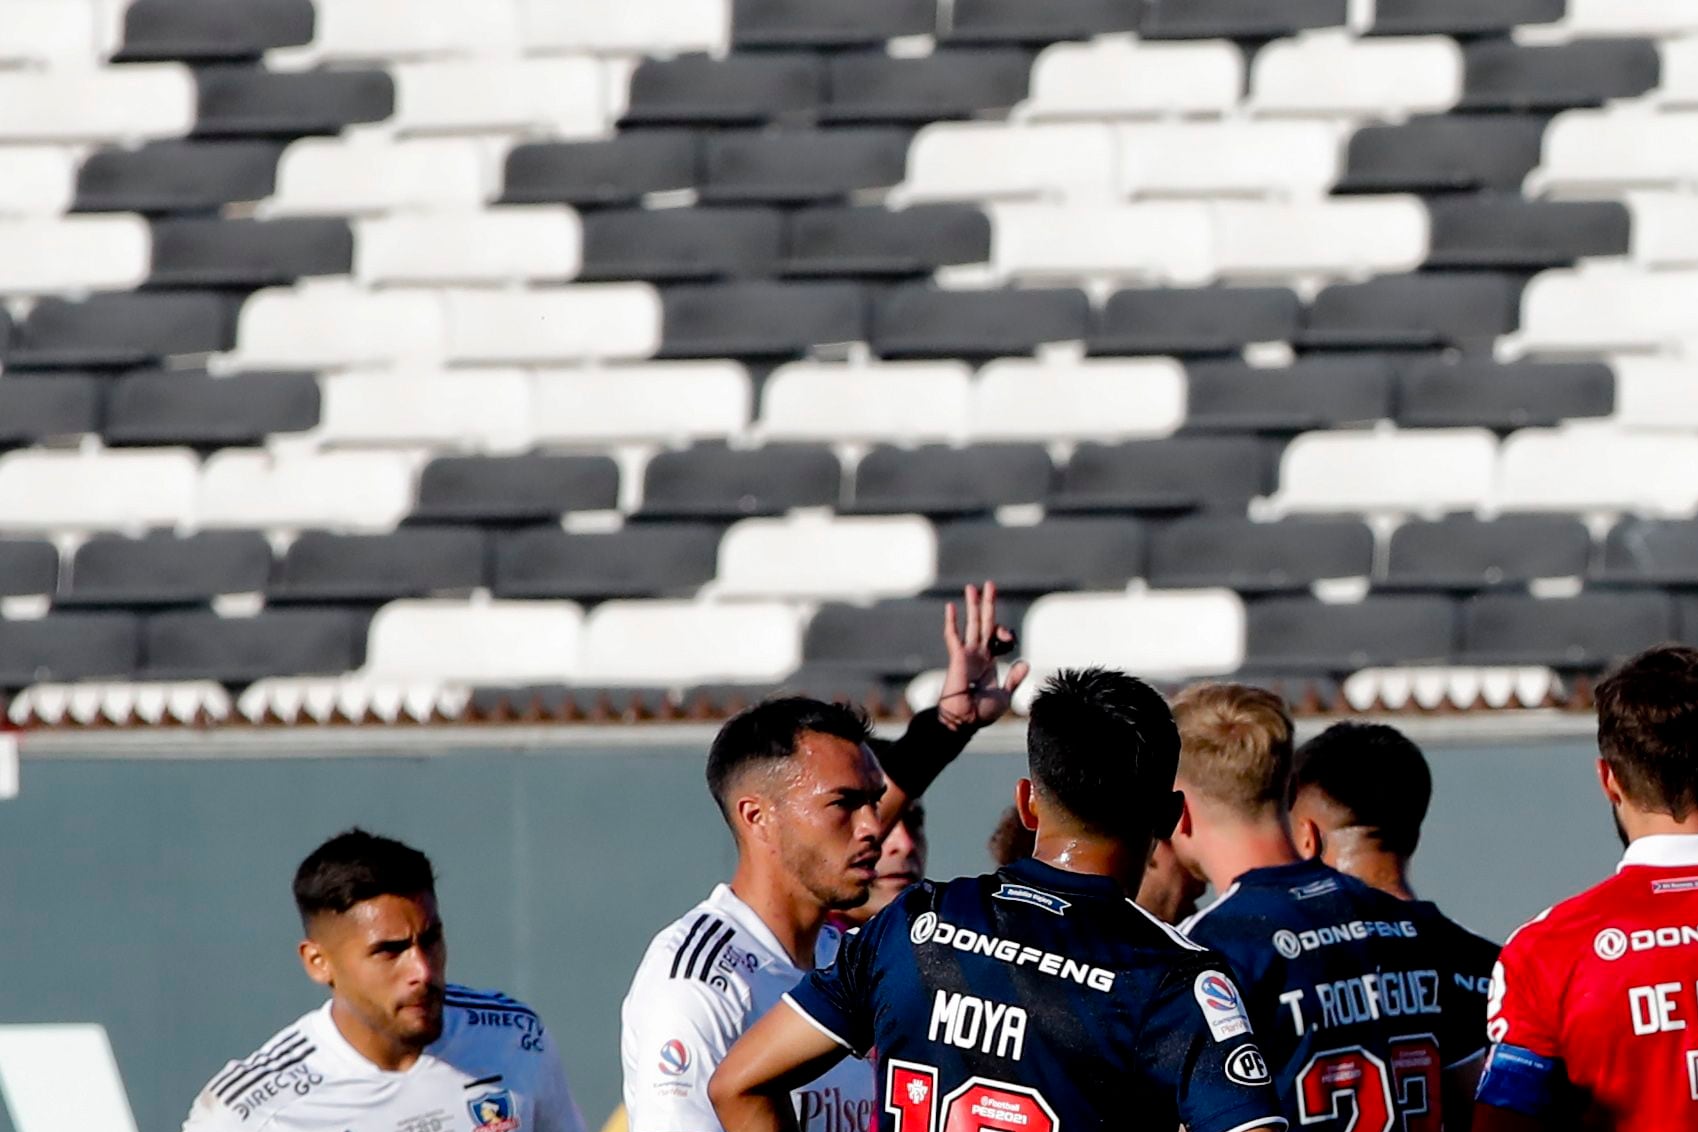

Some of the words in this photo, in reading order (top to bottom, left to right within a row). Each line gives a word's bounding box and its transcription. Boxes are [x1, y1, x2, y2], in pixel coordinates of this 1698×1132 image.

[933, 922, 1116, 992] DONGFENG
[1299, 920, 1417, 951] DONGFENG
[928, 989, 1028, 1061] MOYA
[1279, 989, 1319, 1036] T.
[1628, 981, 1687, 1036] DE
[233, 1063, 312, 1121] DIRECTV
